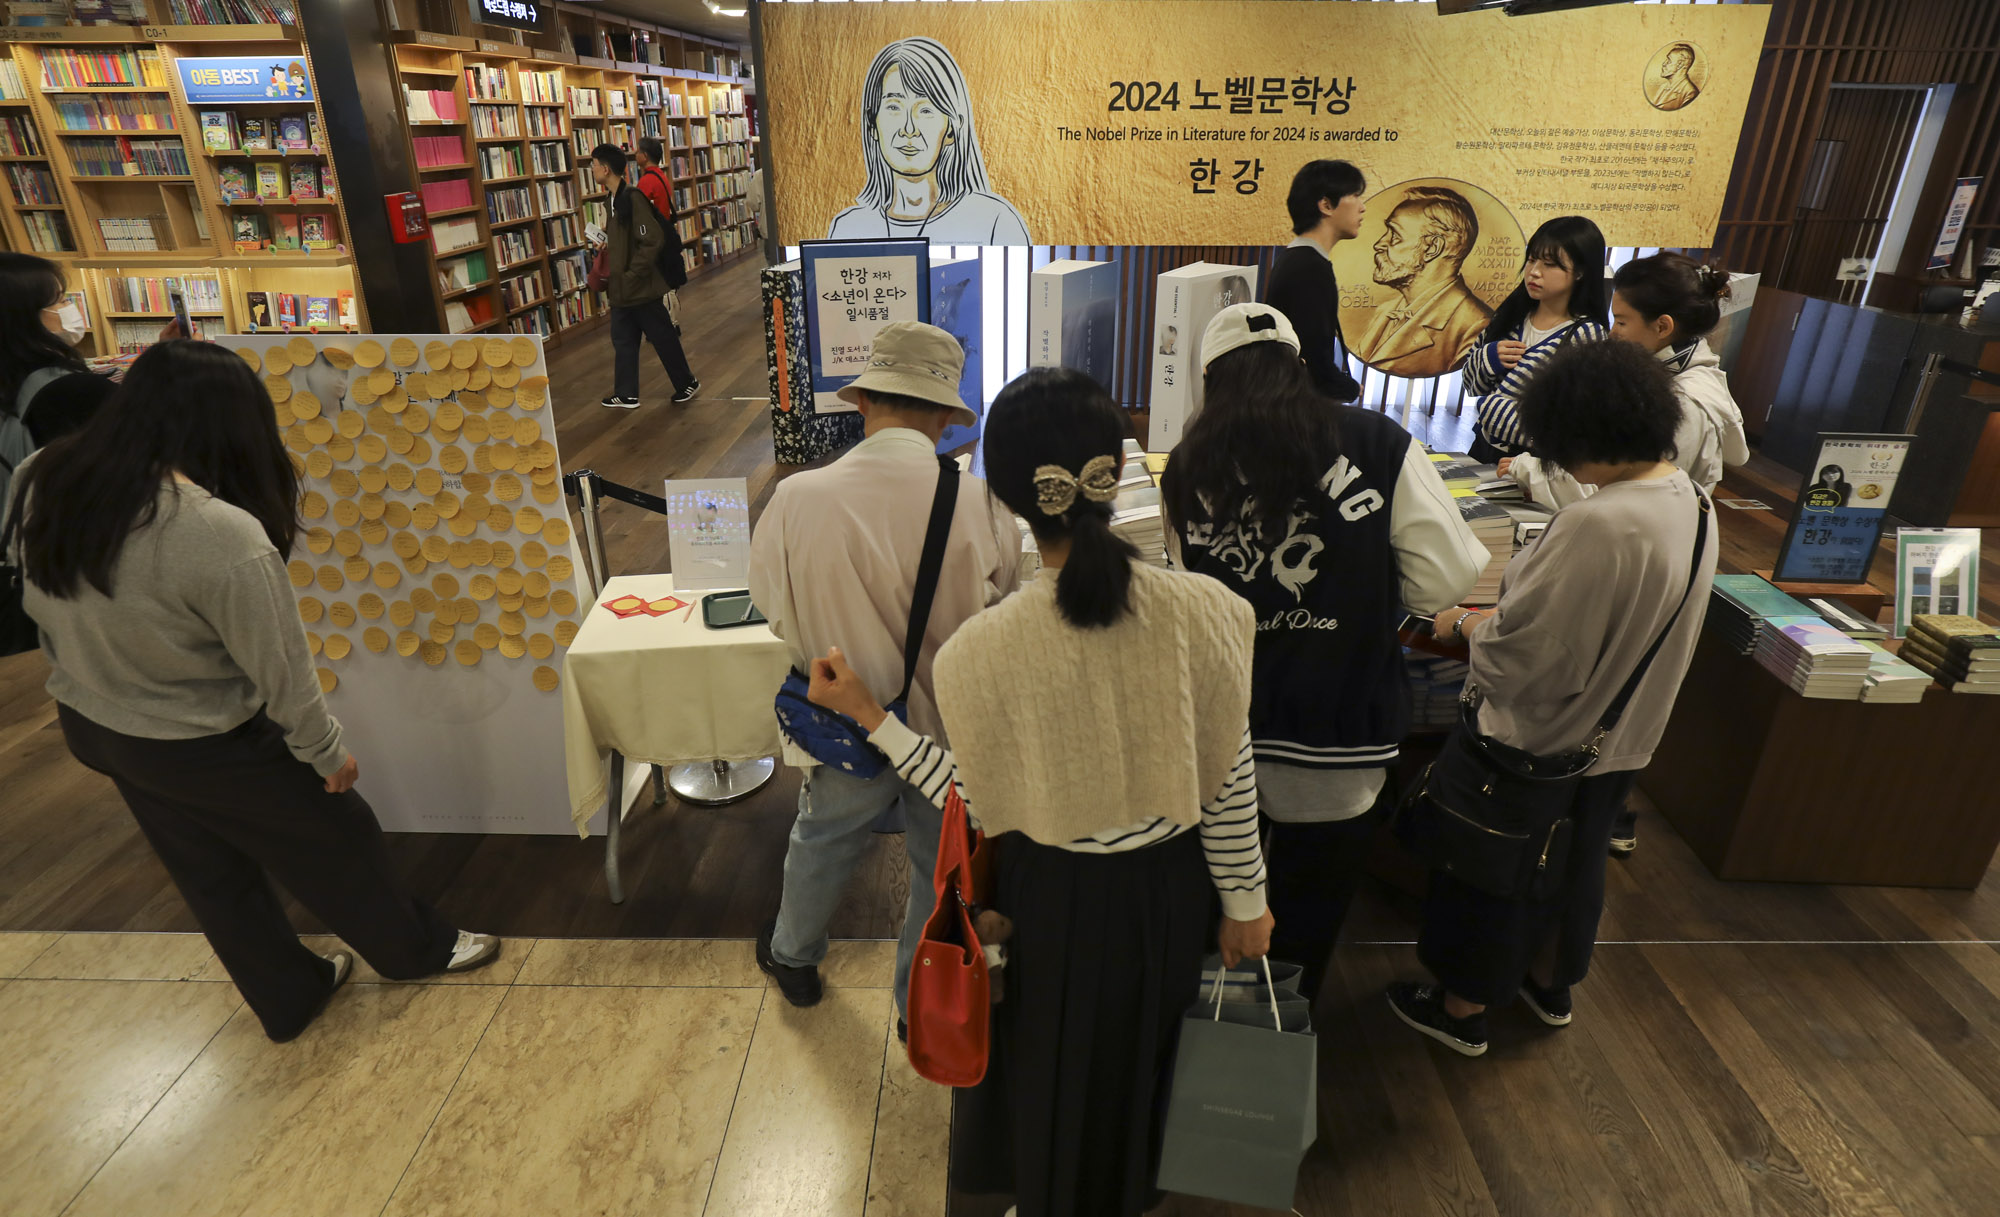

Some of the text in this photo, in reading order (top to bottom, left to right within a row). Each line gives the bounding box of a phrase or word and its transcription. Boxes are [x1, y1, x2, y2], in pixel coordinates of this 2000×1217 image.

[190, 68, 260, 86] 아동 BEST
[1107, 76, 1357, 116] 2024 노벨문학상
[1057, 126, 1399, 143] The Nobel Prize in Literature for 2024 is awarded to
[1189, 157, 1264, 195] 한 강
[1474, 246, 1520, 257] MDCCC
[840, 267, 892, 285] 한강 저자
[822, 286, 908, 304] <소년이 온다>
[1339, 296, 1378, 308] OBEL
[846, 307, 890, 322] 일시품절
[831, 344, 870, 356] 진열 도서 외
[1821, 515, 1849, 528] 문학상
